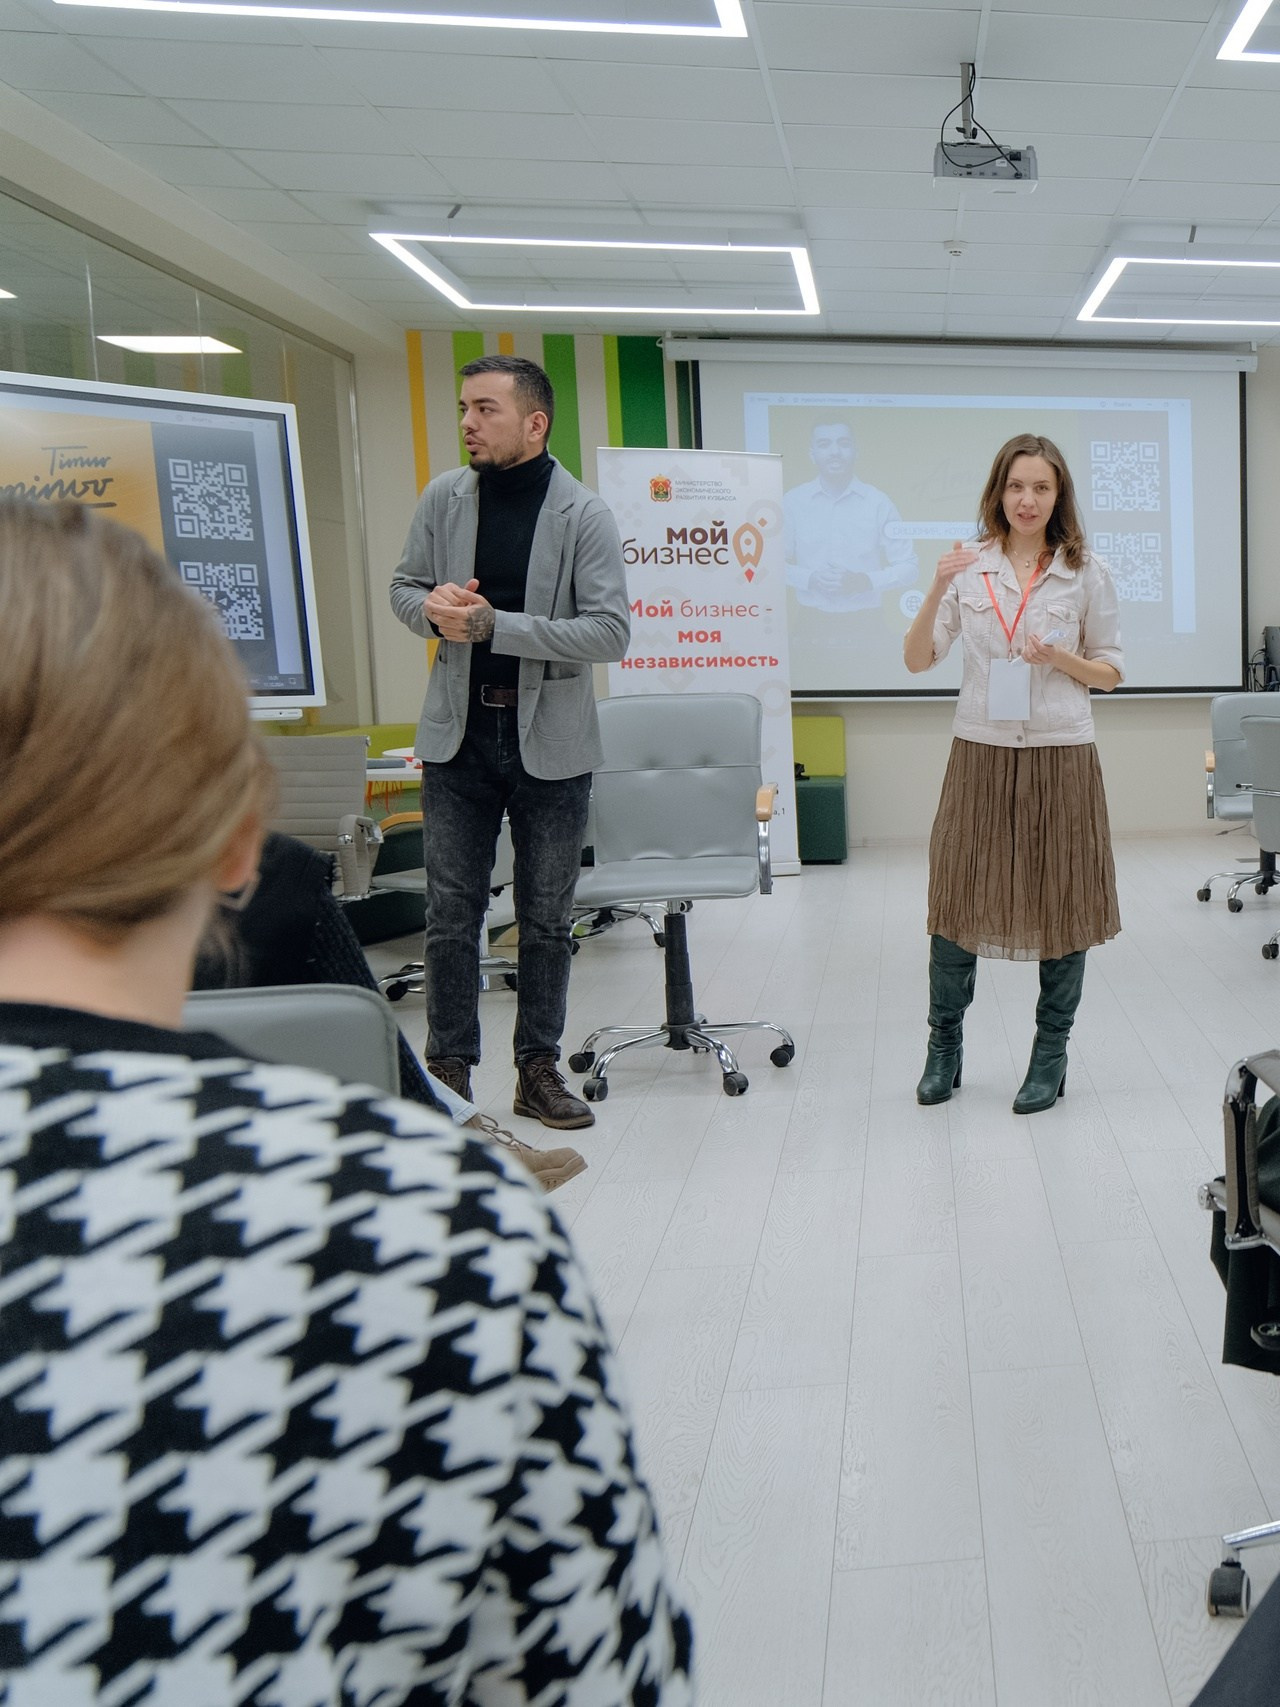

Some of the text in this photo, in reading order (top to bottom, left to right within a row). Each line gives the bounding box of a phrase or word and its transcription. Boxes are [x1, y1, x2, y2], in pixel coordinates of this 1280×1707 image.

[666, 520, 729, 545] мой
[622, 538, 730, 565] бизнес
[629, 599, 674, 618] Мой
[680, 600, 760, 618] бизнес
[677, 630, 722, 643] моя
[621, 655, 779, 669] независимость
